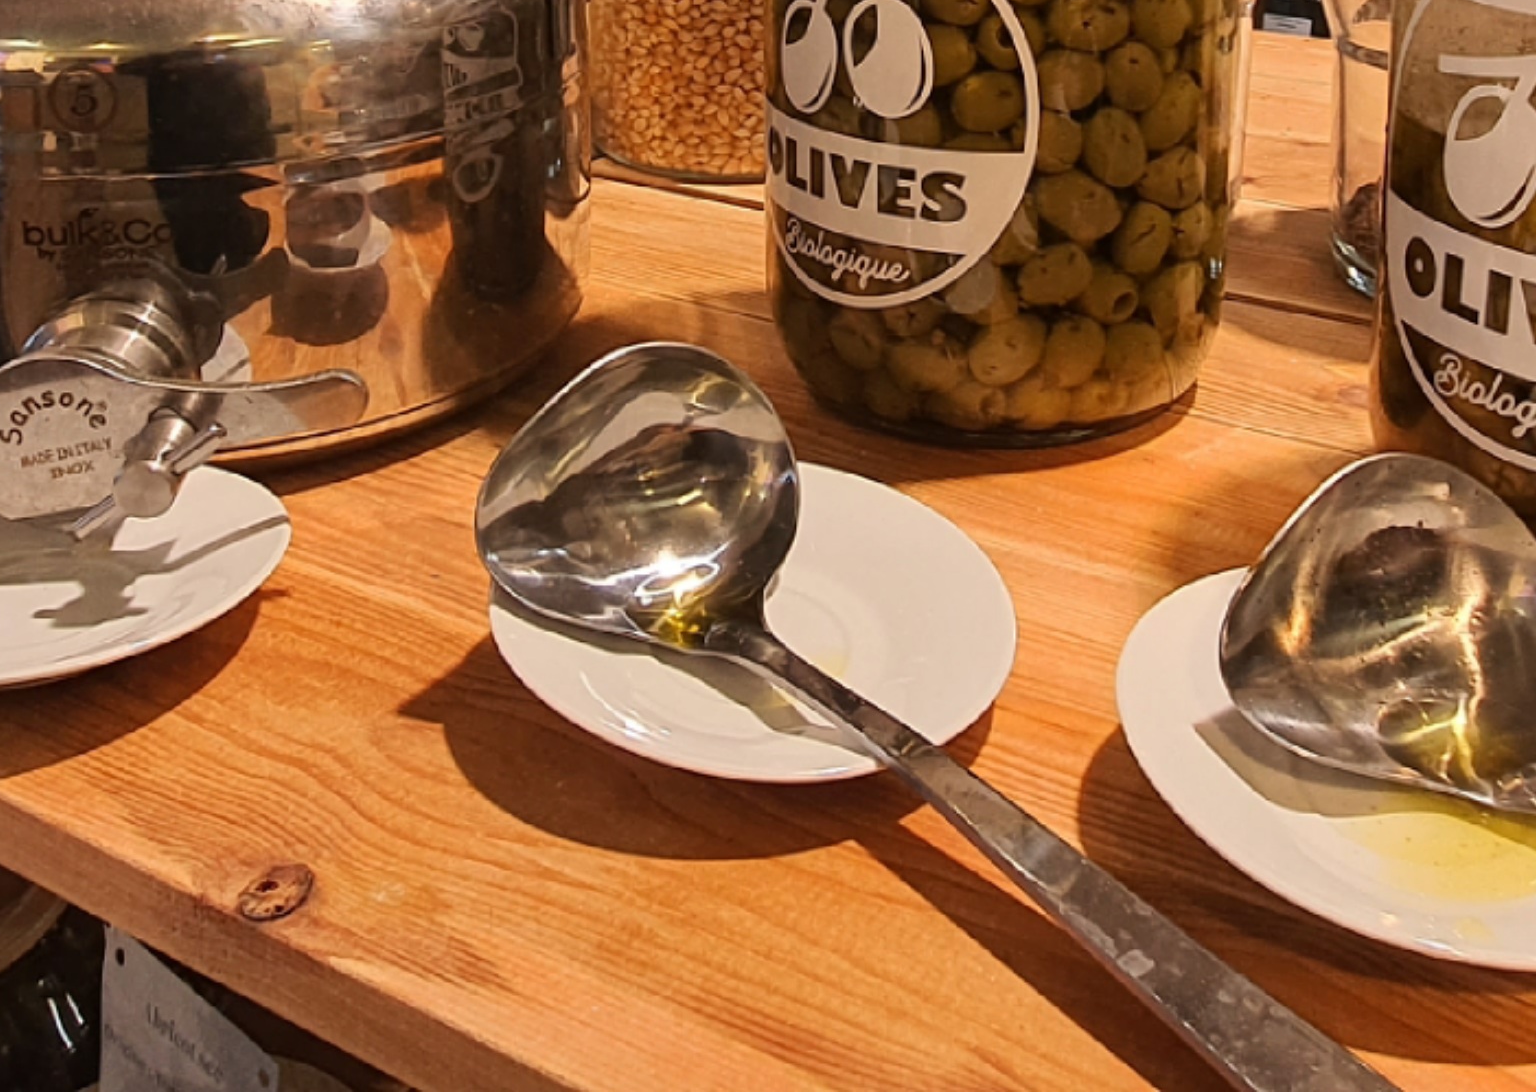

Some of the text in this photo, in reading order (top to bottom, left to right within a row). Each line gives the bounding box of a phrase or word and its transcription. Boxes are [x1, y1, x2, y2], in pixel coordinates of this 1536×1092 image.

[768, 125, 967, 223] OLIVES
[784, 216, 911, 290] Biologique
[20, 448, 55, 469] MADE
[75, 437, 112, 459] ITALY
[49, 460, 95, 480] INOX
